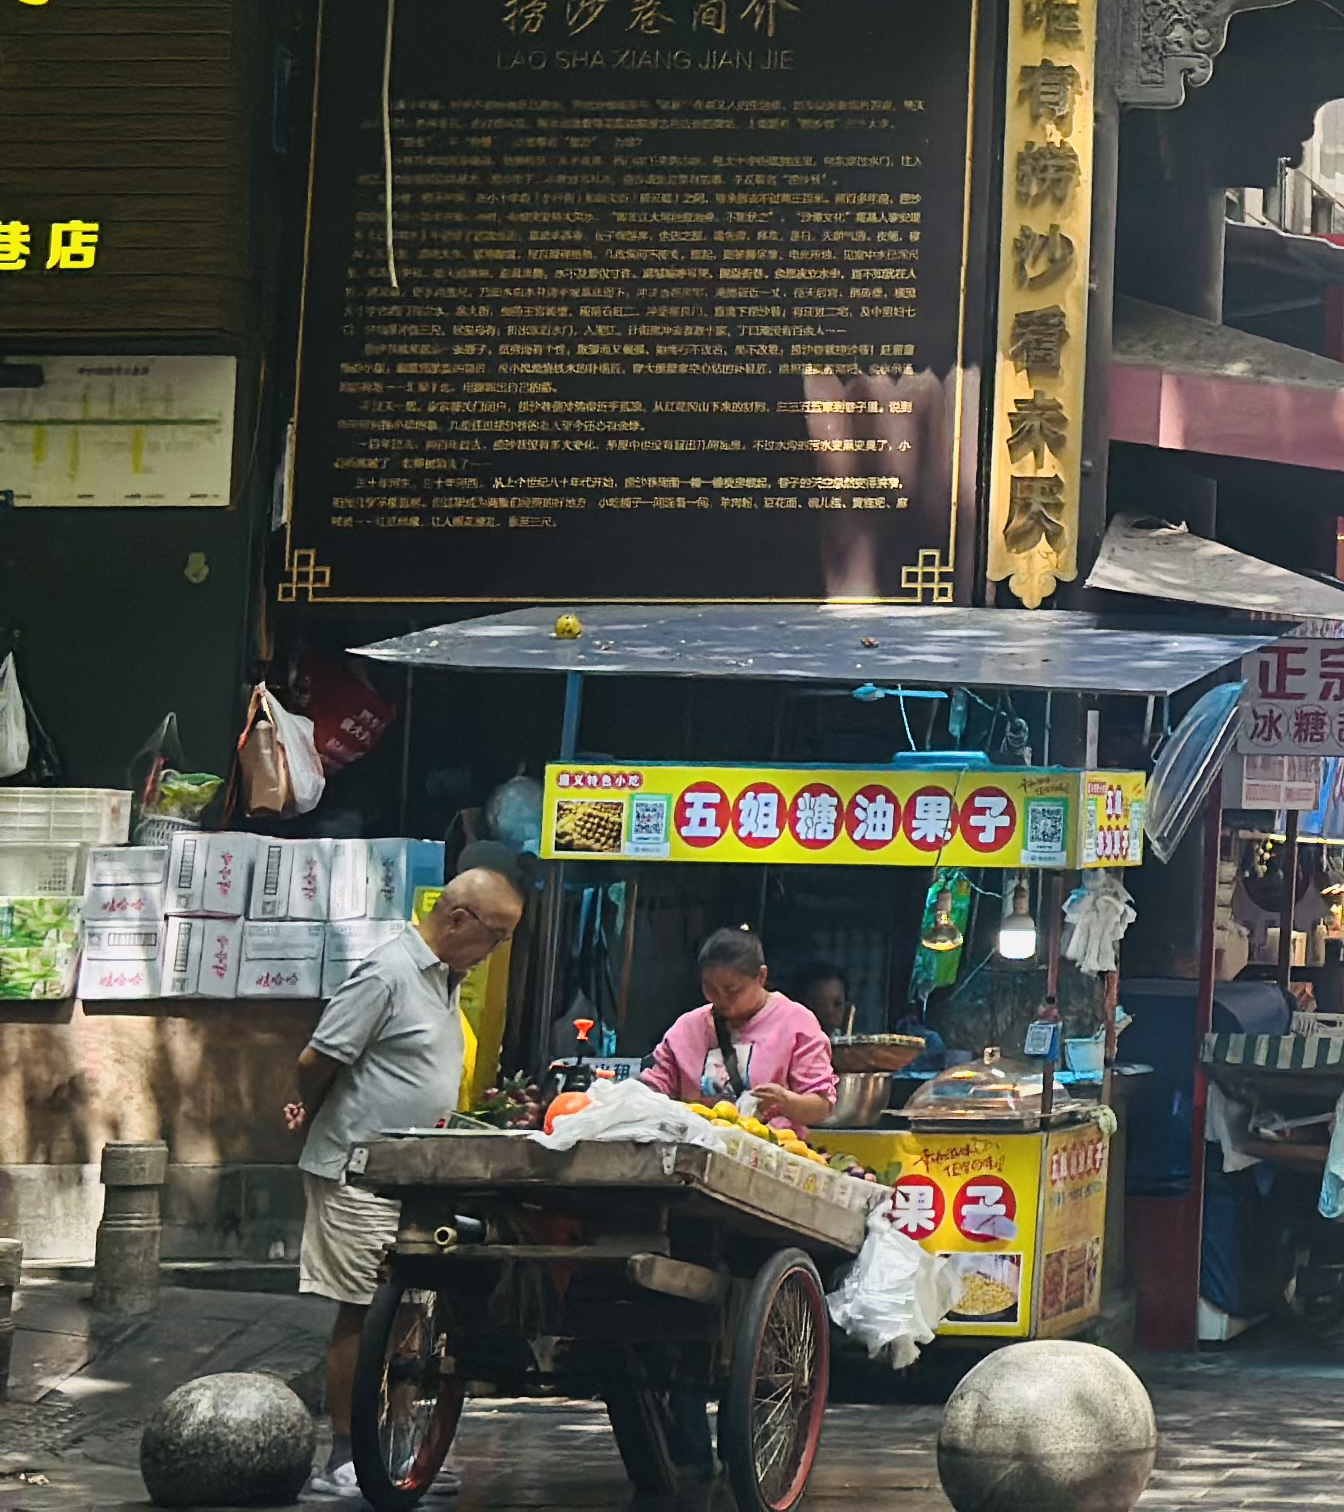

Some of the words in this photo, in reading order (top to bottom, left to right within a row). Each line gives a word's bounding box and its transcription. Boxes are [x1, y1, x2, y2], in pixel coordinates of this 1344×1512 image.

[498, 50, 547, 71] LAO
[556, 50, 605, 71] SHA
[611, 50, 692, 71] XIANG
[698, 50, 754, 71] JIAN
[761, 50, 797, 71] JIE
[681, 791, 1010, 841] 五姐糖油果子
[103, 899, 144, 912] 娃哈哈
[100, 972, 143, 987] 娃哈哈
[256, 972, 299, 988] 娃哈哈
